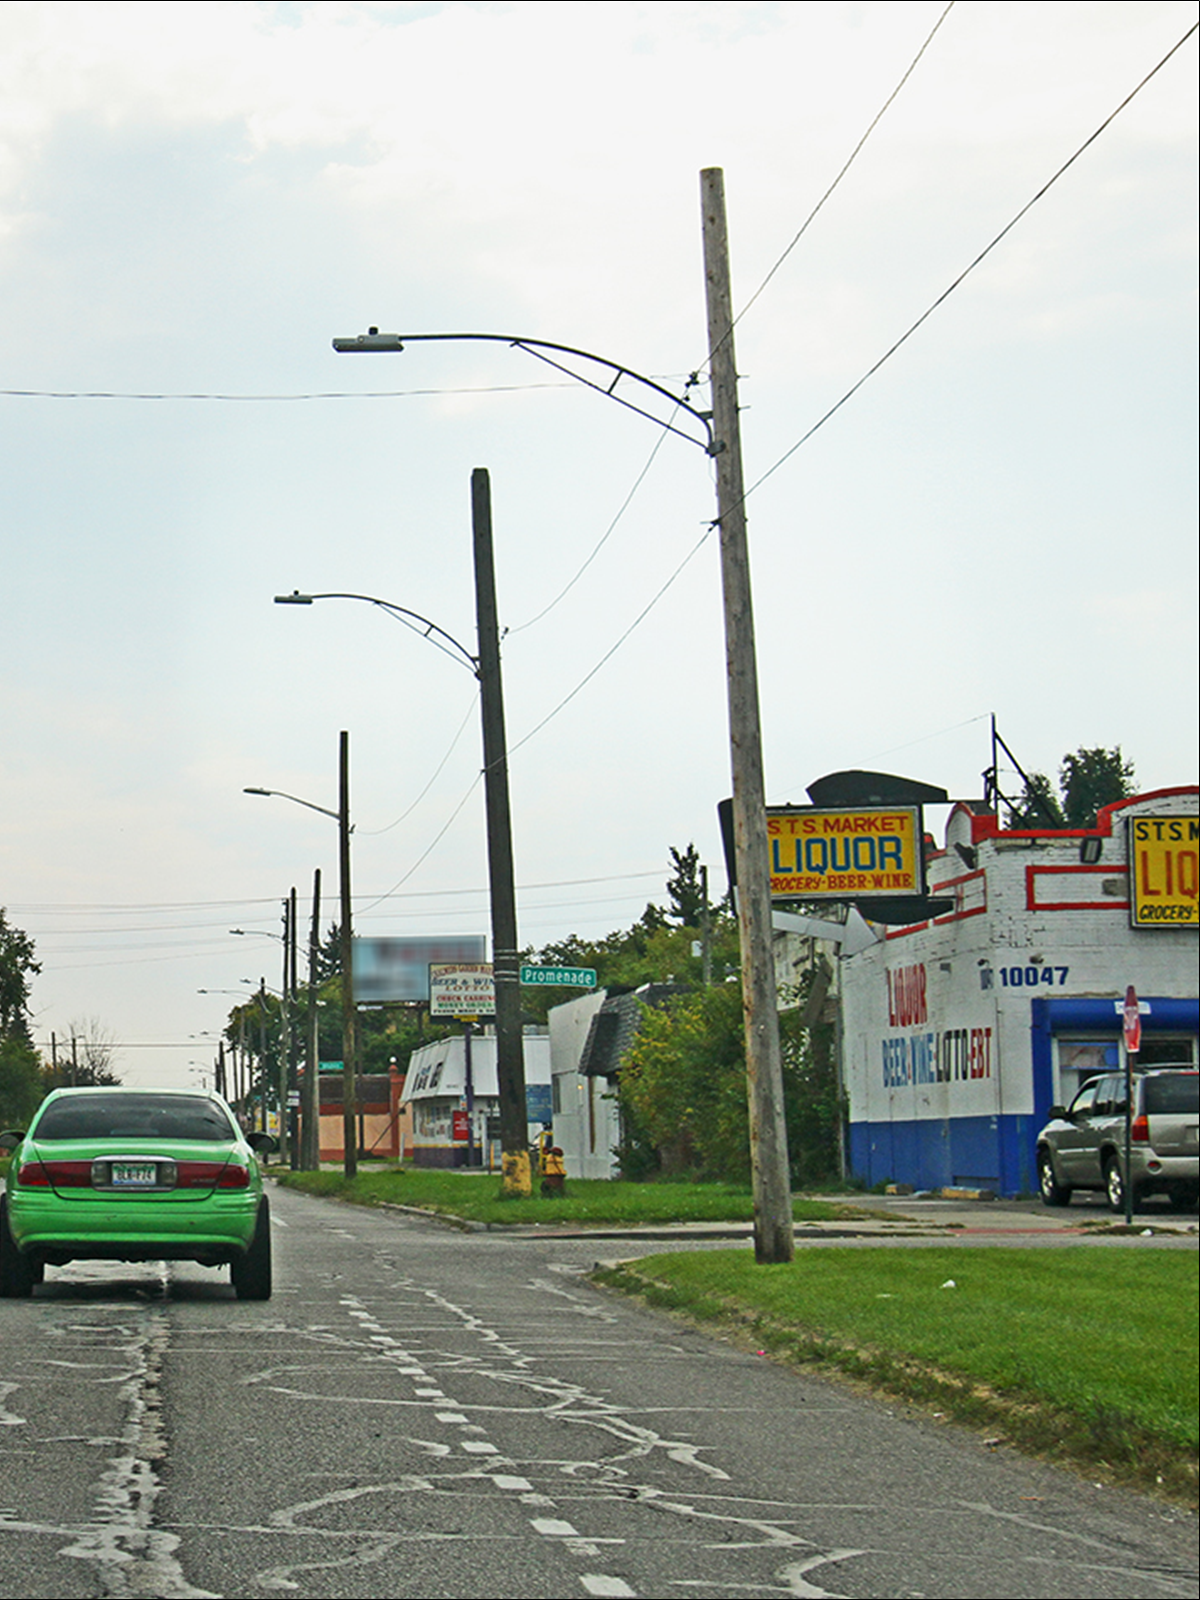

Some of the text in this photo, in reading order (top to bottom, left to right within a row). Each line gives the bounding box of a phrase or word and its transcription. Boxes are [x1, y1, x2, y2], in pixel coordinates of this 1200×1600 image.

[823, 816, 908, 833] MARKET
[772, 836, 903, 875] LIQUOR
[525, 969, 592, 985] Promenade
[999, 966, 1070, 987] 10047
[887, 963, 927, 1027] LIQUOR
